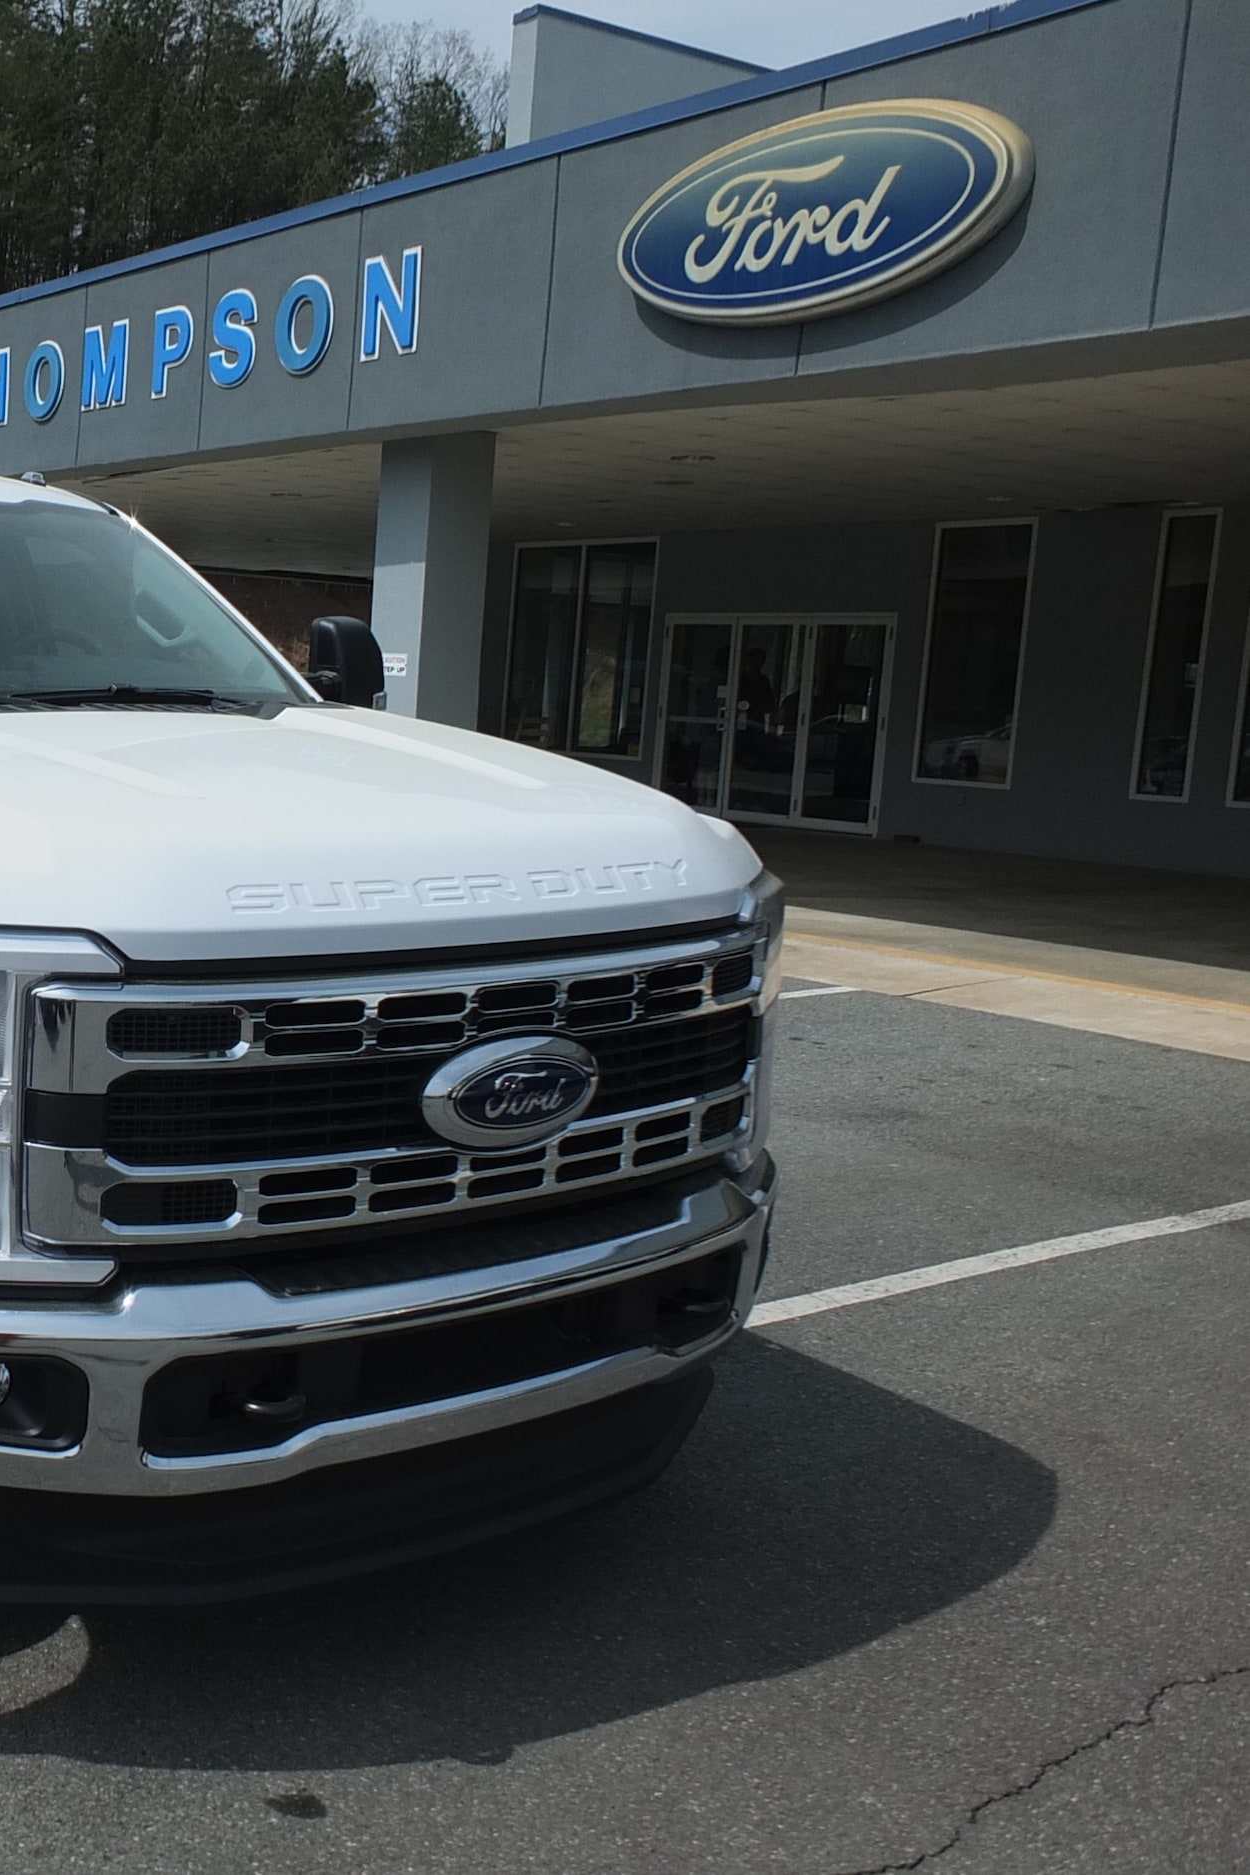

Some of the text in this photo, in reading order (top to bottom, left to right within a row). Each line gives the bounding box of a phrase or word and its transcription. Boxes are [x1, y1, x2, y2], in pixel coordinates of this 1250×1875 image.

[684, 155, 902, 284] Ford
[225, 858, 689, 914] SUPER DUTY
[484, 1070, 568, 1119] Ford
